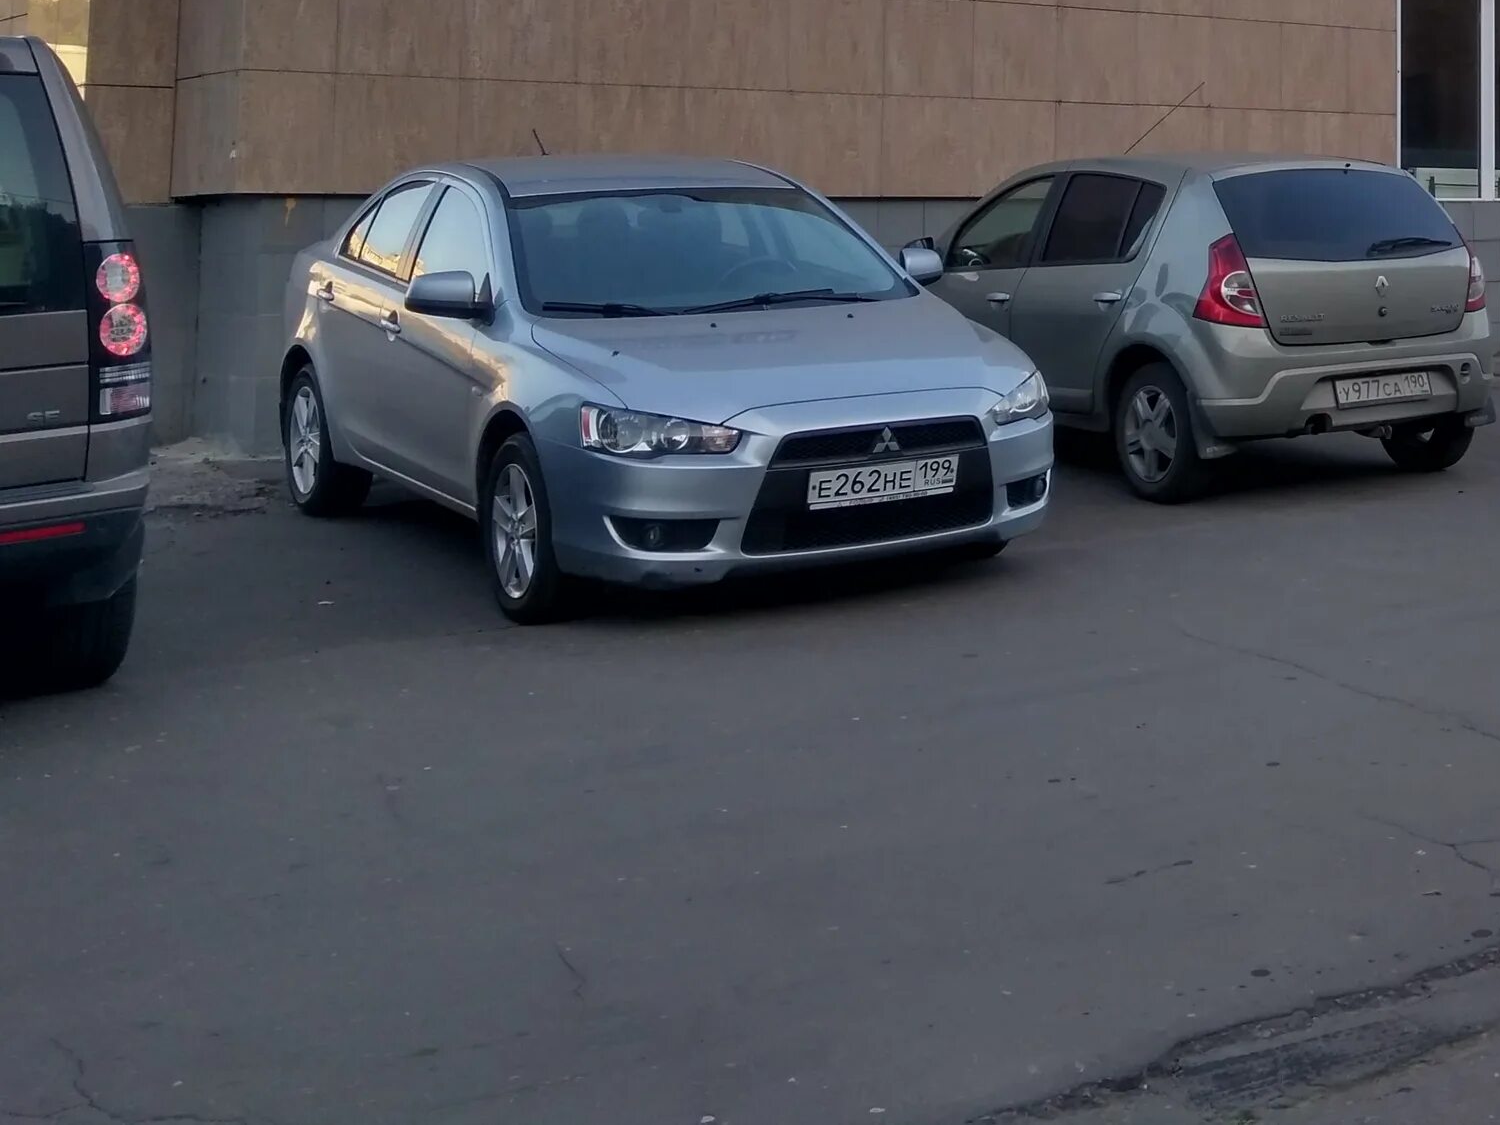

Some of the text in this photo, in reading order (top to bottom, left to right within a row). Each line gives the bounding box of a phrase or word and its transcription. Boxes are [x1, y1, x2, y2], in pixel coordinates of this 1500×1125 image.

[1403, 373, 1425, 389] 190
[817, 469, 913, 499] Е262НЕ
[918, 459, 953, 480] 199
[923, 477, 942, 487] RUS
